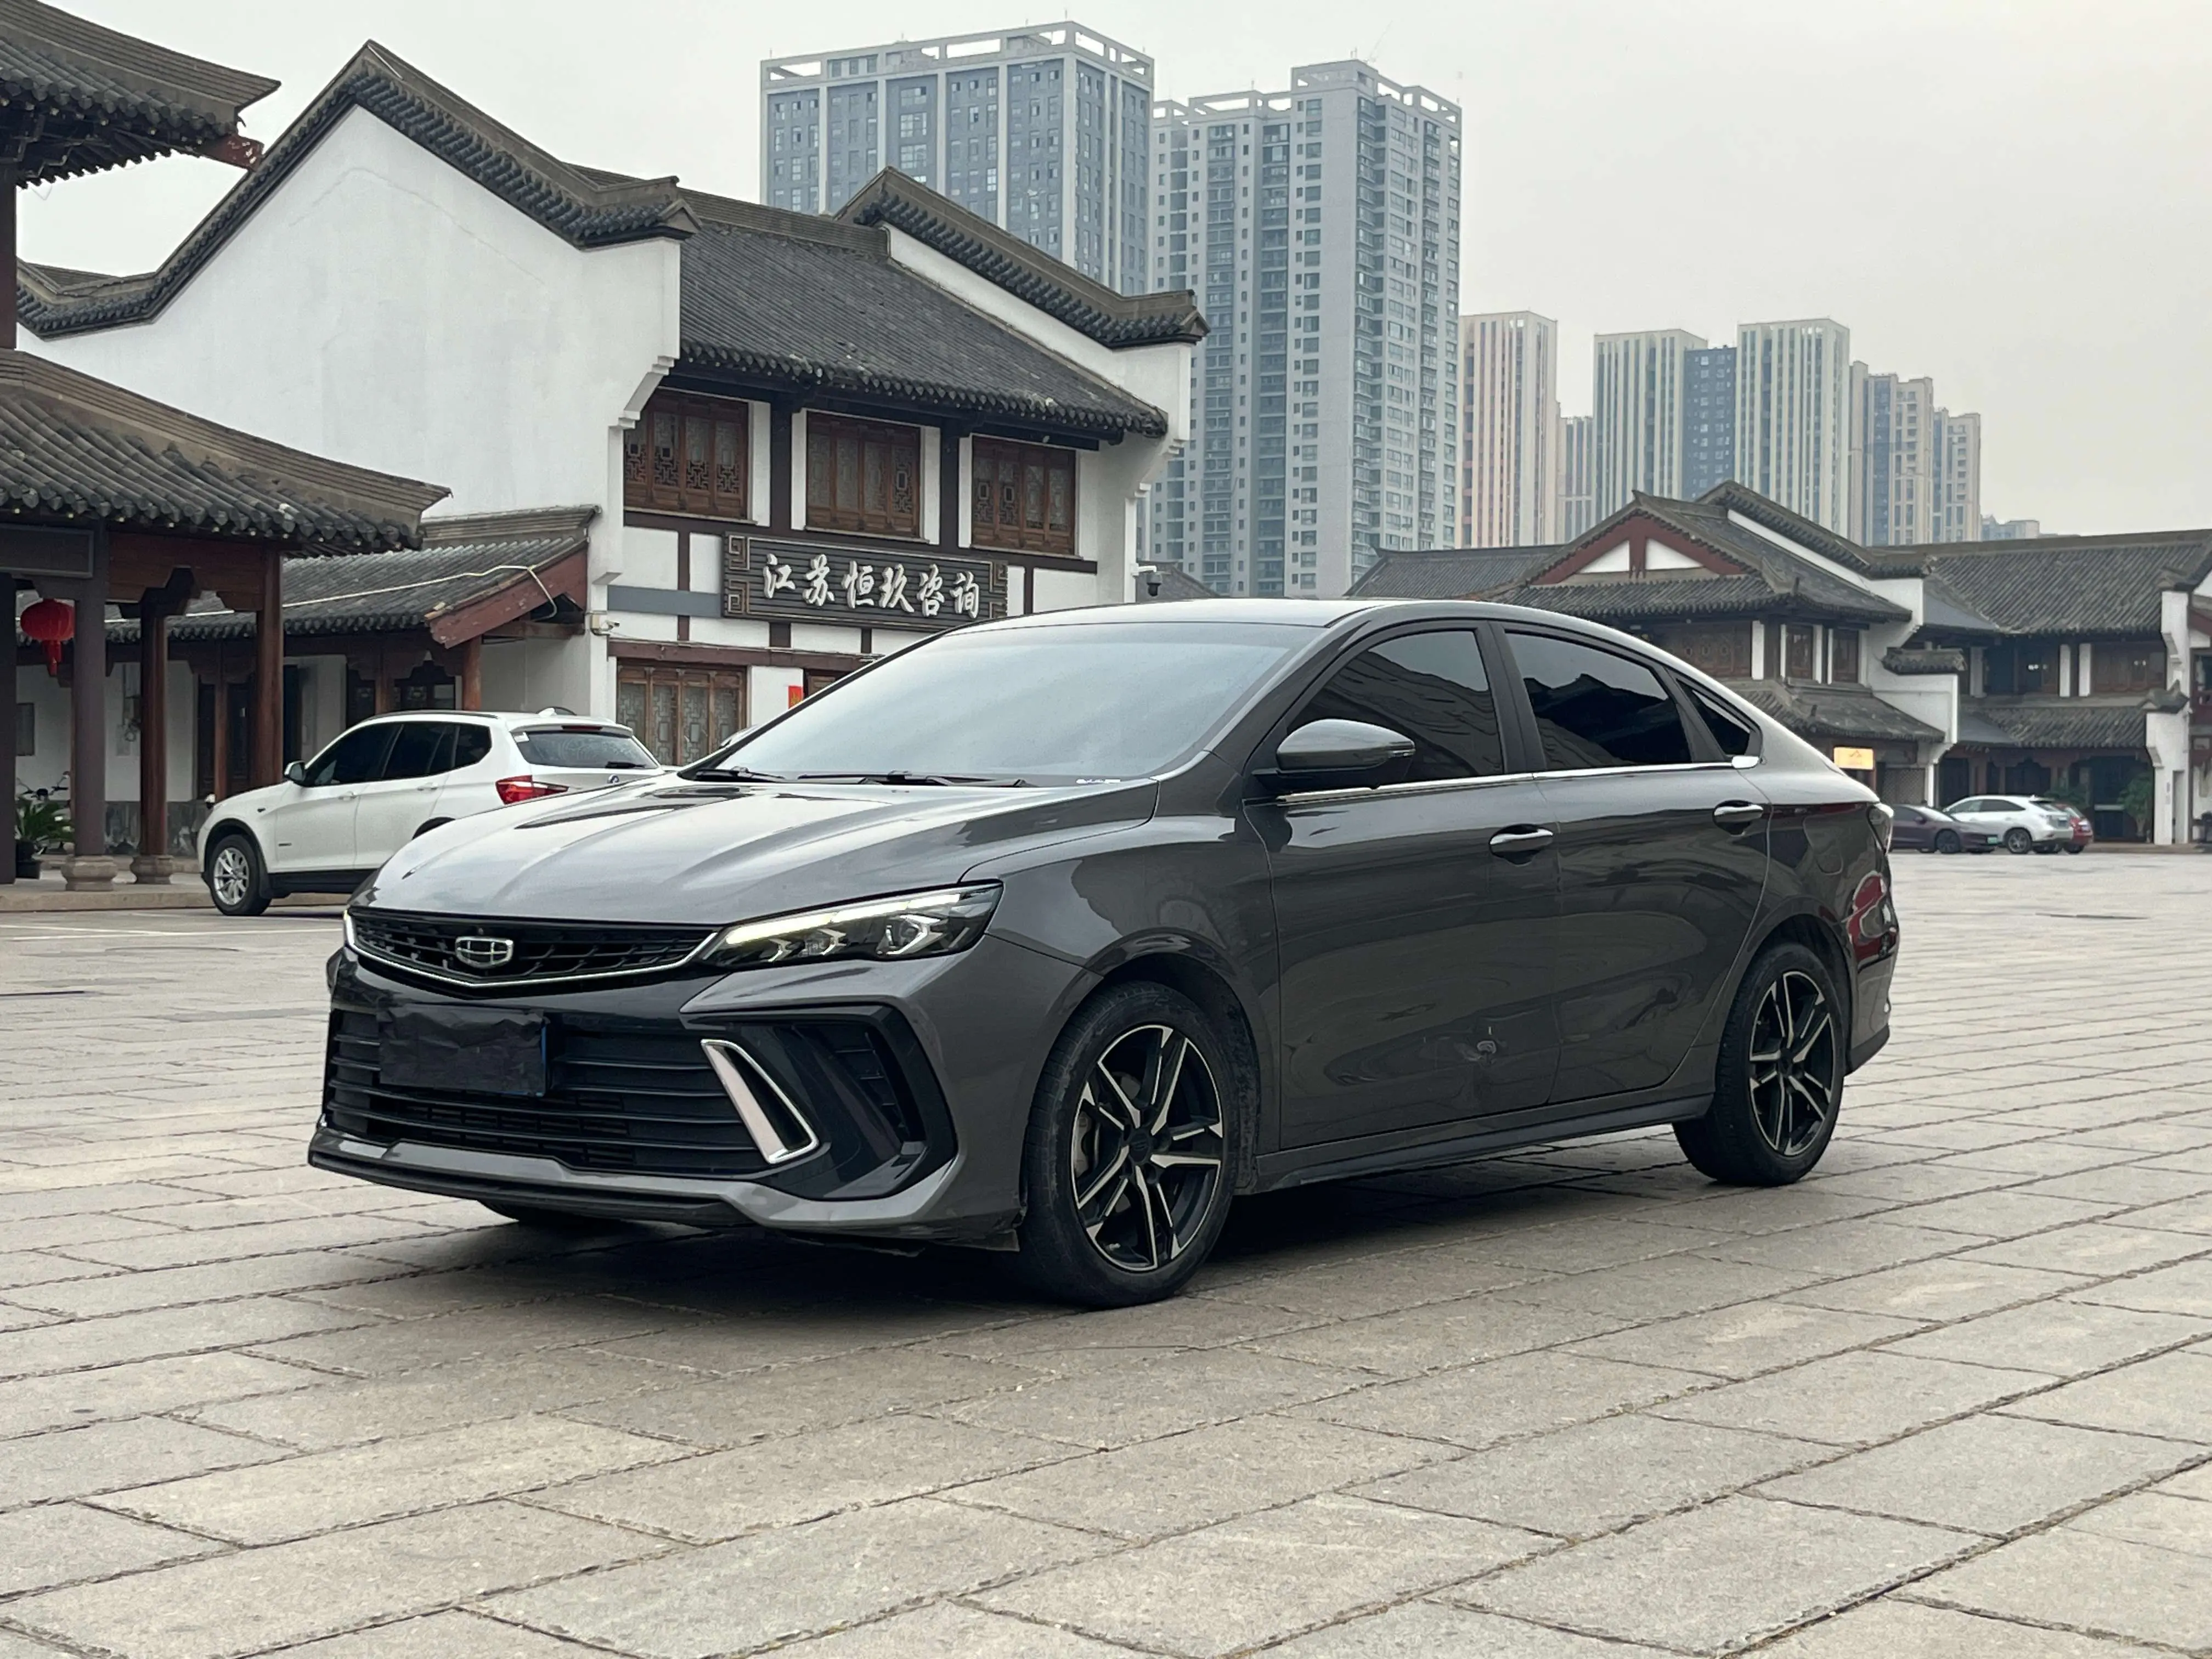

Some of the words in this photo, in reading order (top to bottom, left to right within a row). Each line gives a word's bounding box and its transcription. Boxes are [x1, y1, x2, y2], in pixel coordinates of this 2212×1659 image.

[763, 554, 980, 618] 江苏恒玖咨询
